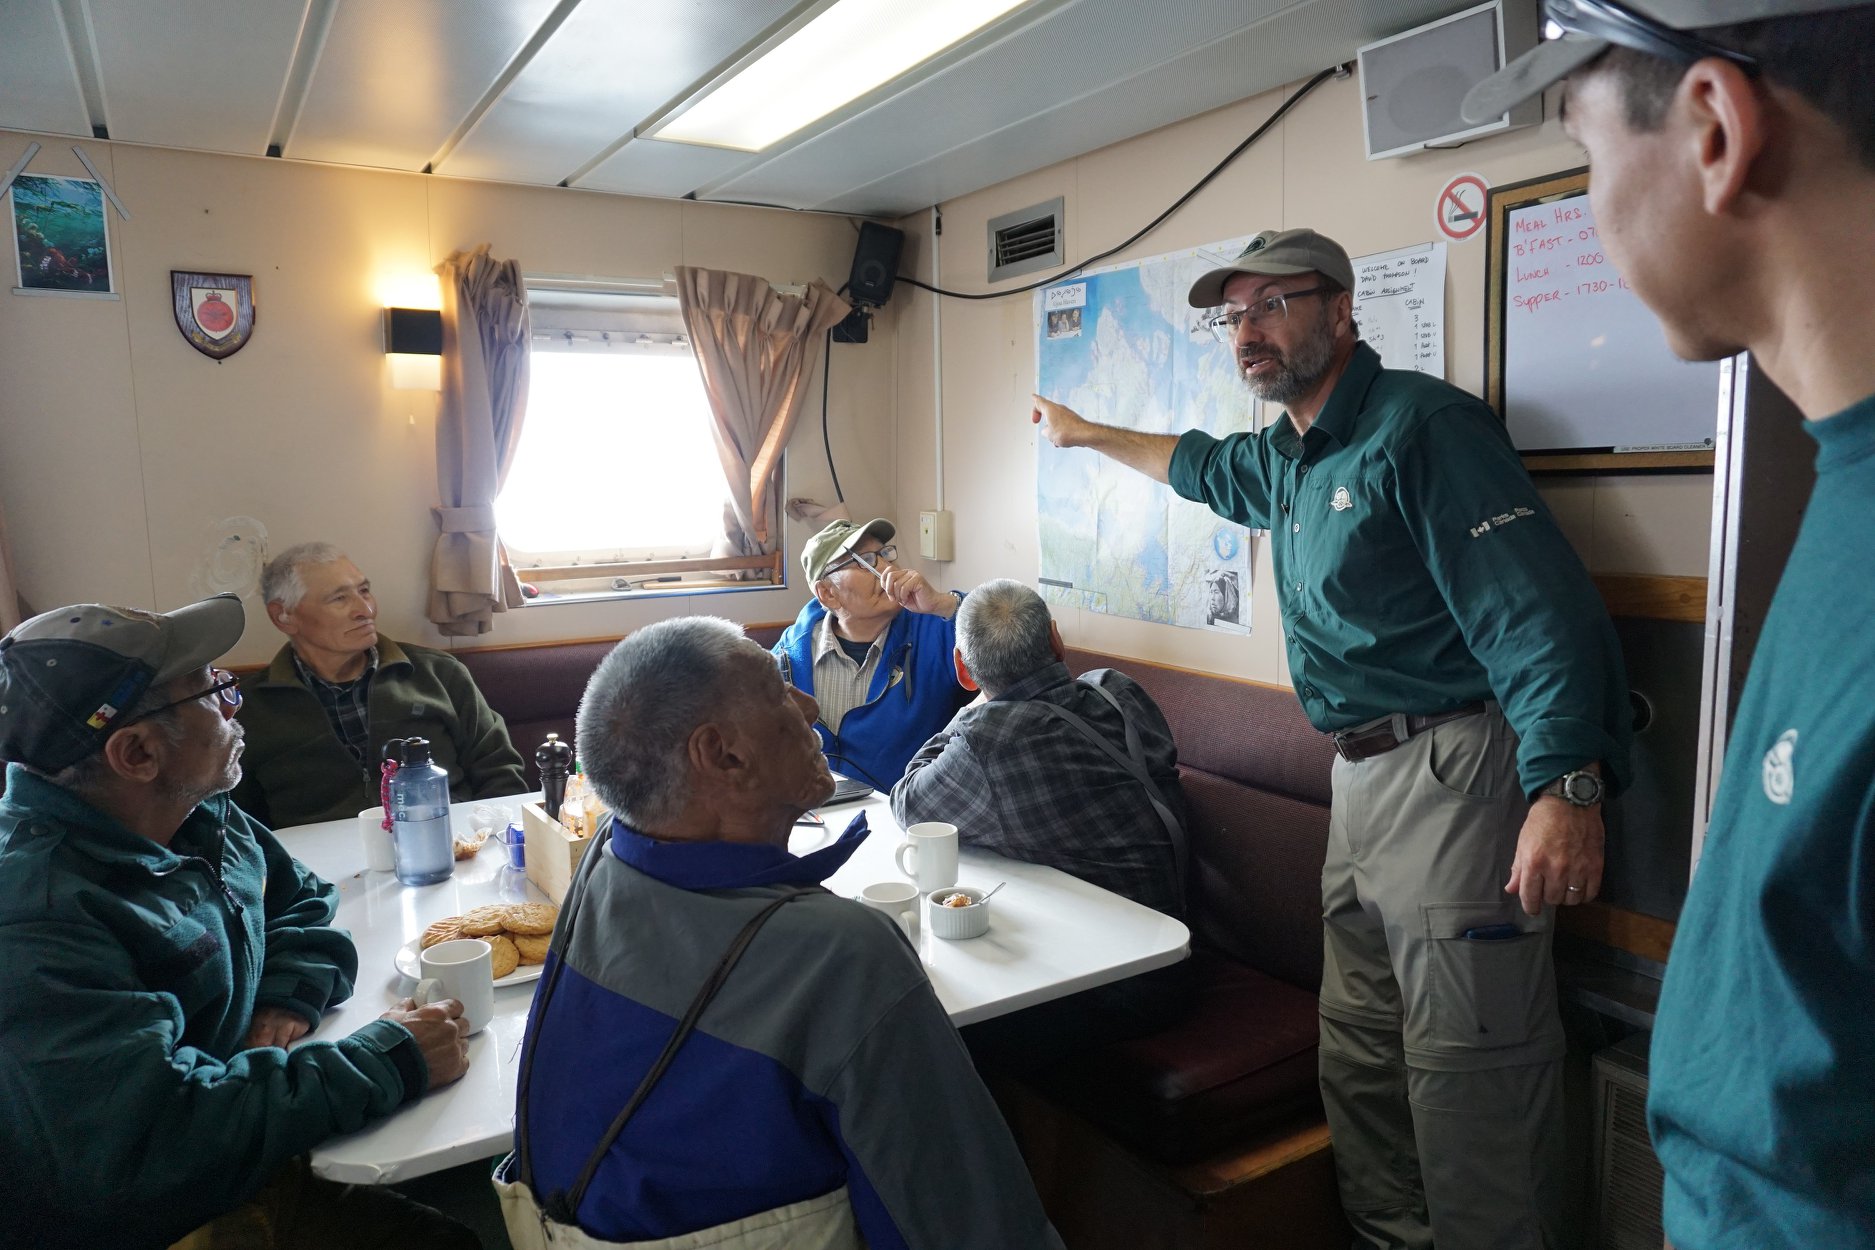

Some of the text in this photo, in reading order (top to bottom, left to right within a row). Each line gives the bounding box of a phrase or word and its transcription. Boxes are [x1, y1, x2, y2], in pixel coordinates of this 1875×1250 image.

[1516, 207, 1587, 233] MEAL HRS.
[1513, 235, 1564, 257] B'FAST
[1362, 264, 1389, 273] WELCOME
[1410, 255, 1430, 265] BOARD
[1516, 266, 1550, 283] LUNCH
[1577, 251, 1605, 267] 1200
[1360, 273, 1377, 283] DAVID
